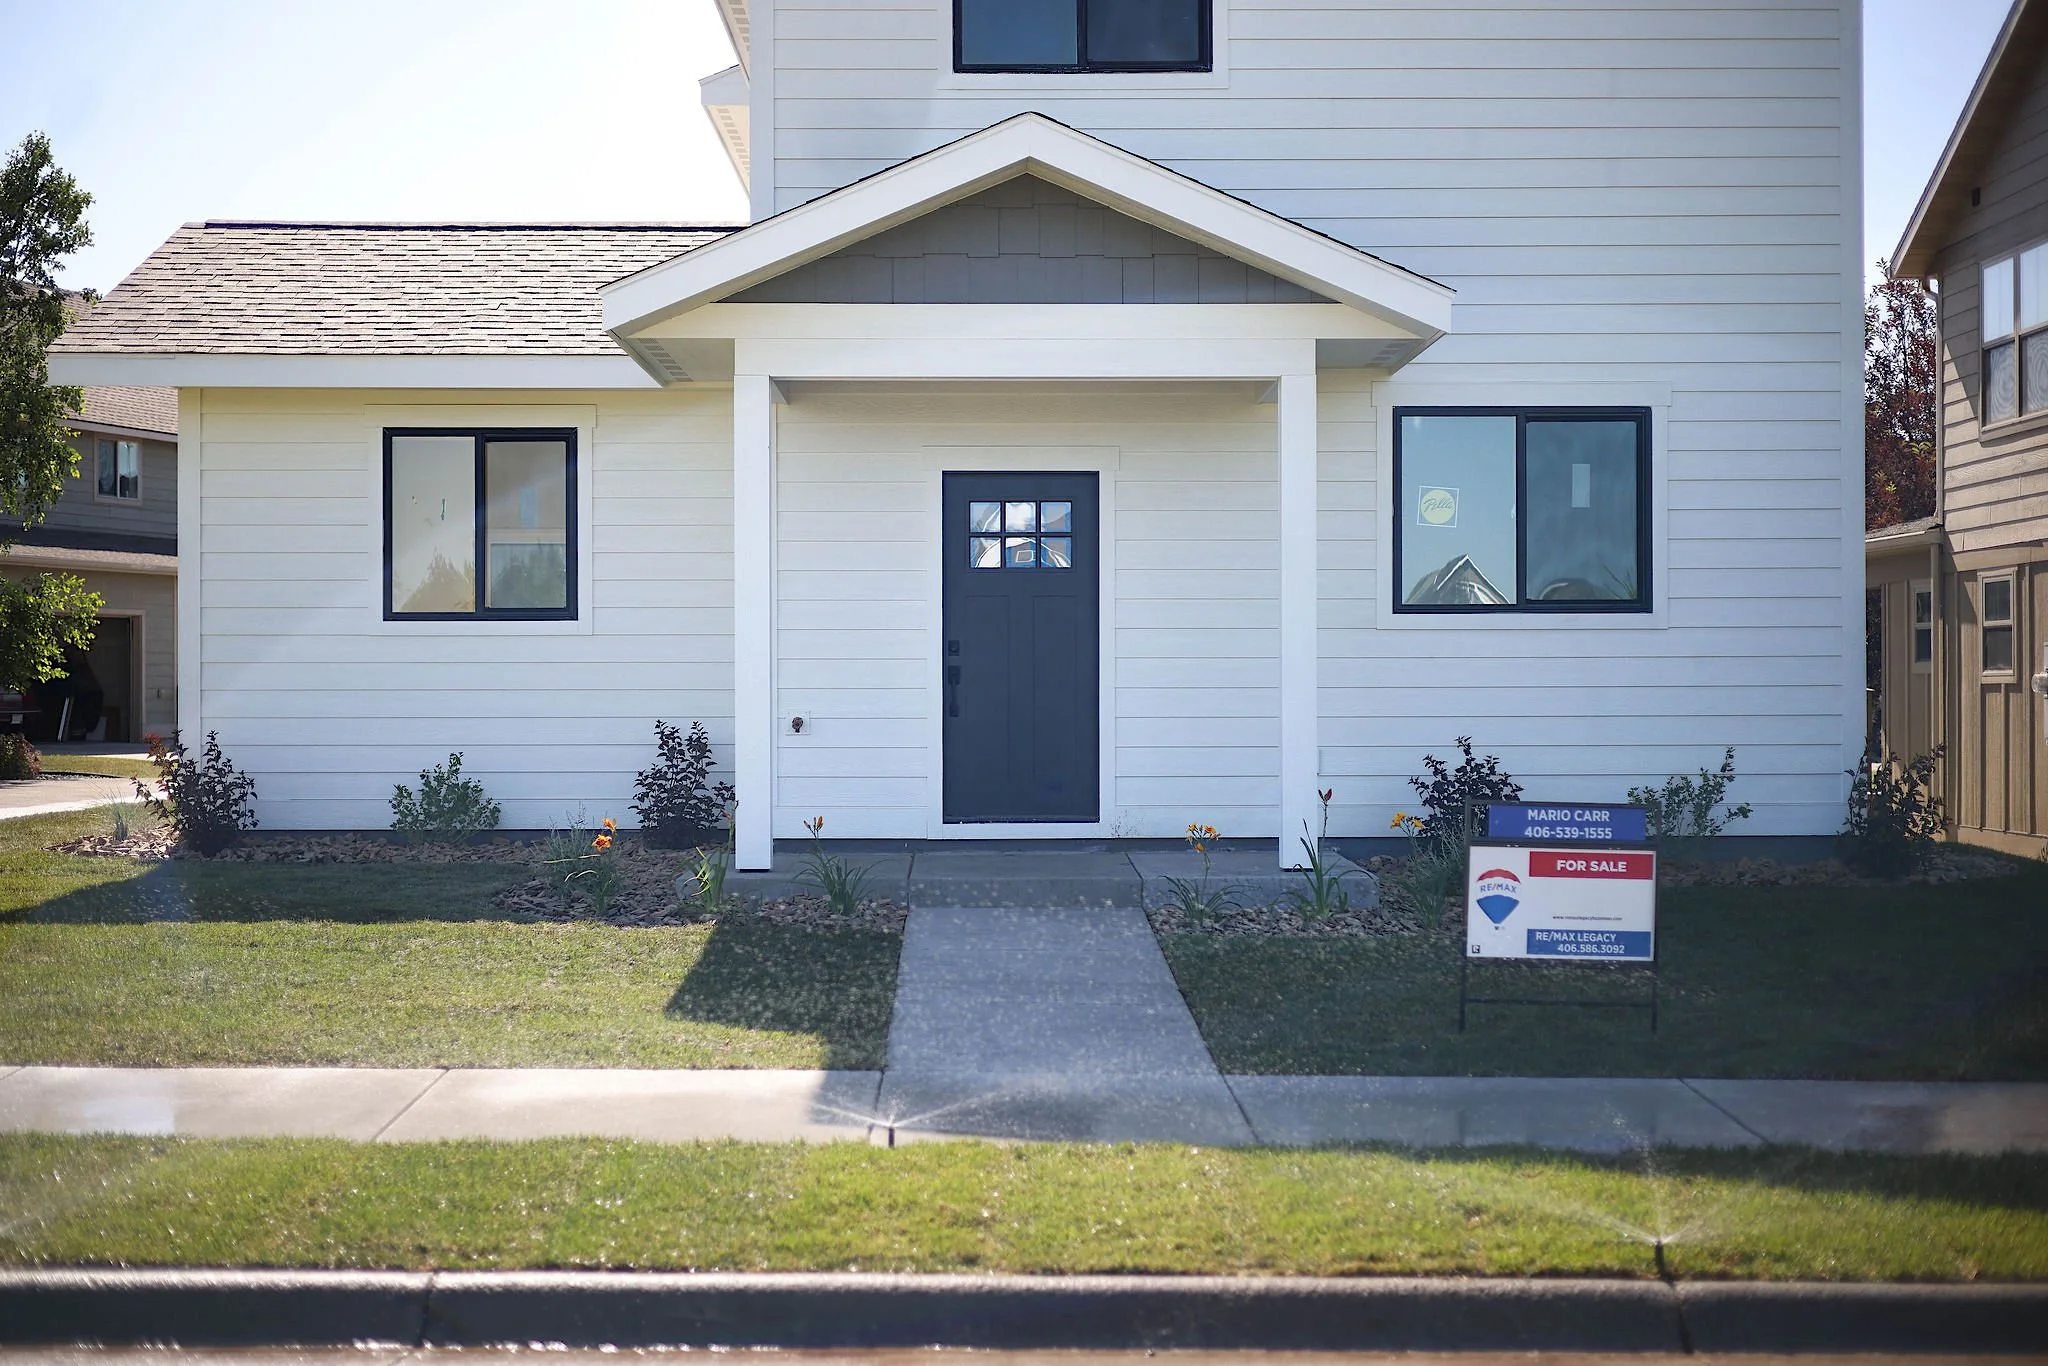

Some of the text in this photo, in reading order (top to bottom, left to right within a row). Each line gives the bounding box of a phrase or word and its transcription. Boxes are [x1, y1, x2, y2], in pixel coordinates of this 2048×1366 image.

[1528, 809, 1610, 822] MARIO CARR
[1524, 826, 1613, 839] 406-539-1555
[1556, 859, 1627, 872] FOR SALE
[1480, 882, 1517, 894] RE/MAX
[1536, 932, 1616, 944] RE/MAX LEGACY
[1557, 944, 1625, 954] 406.586.3092
